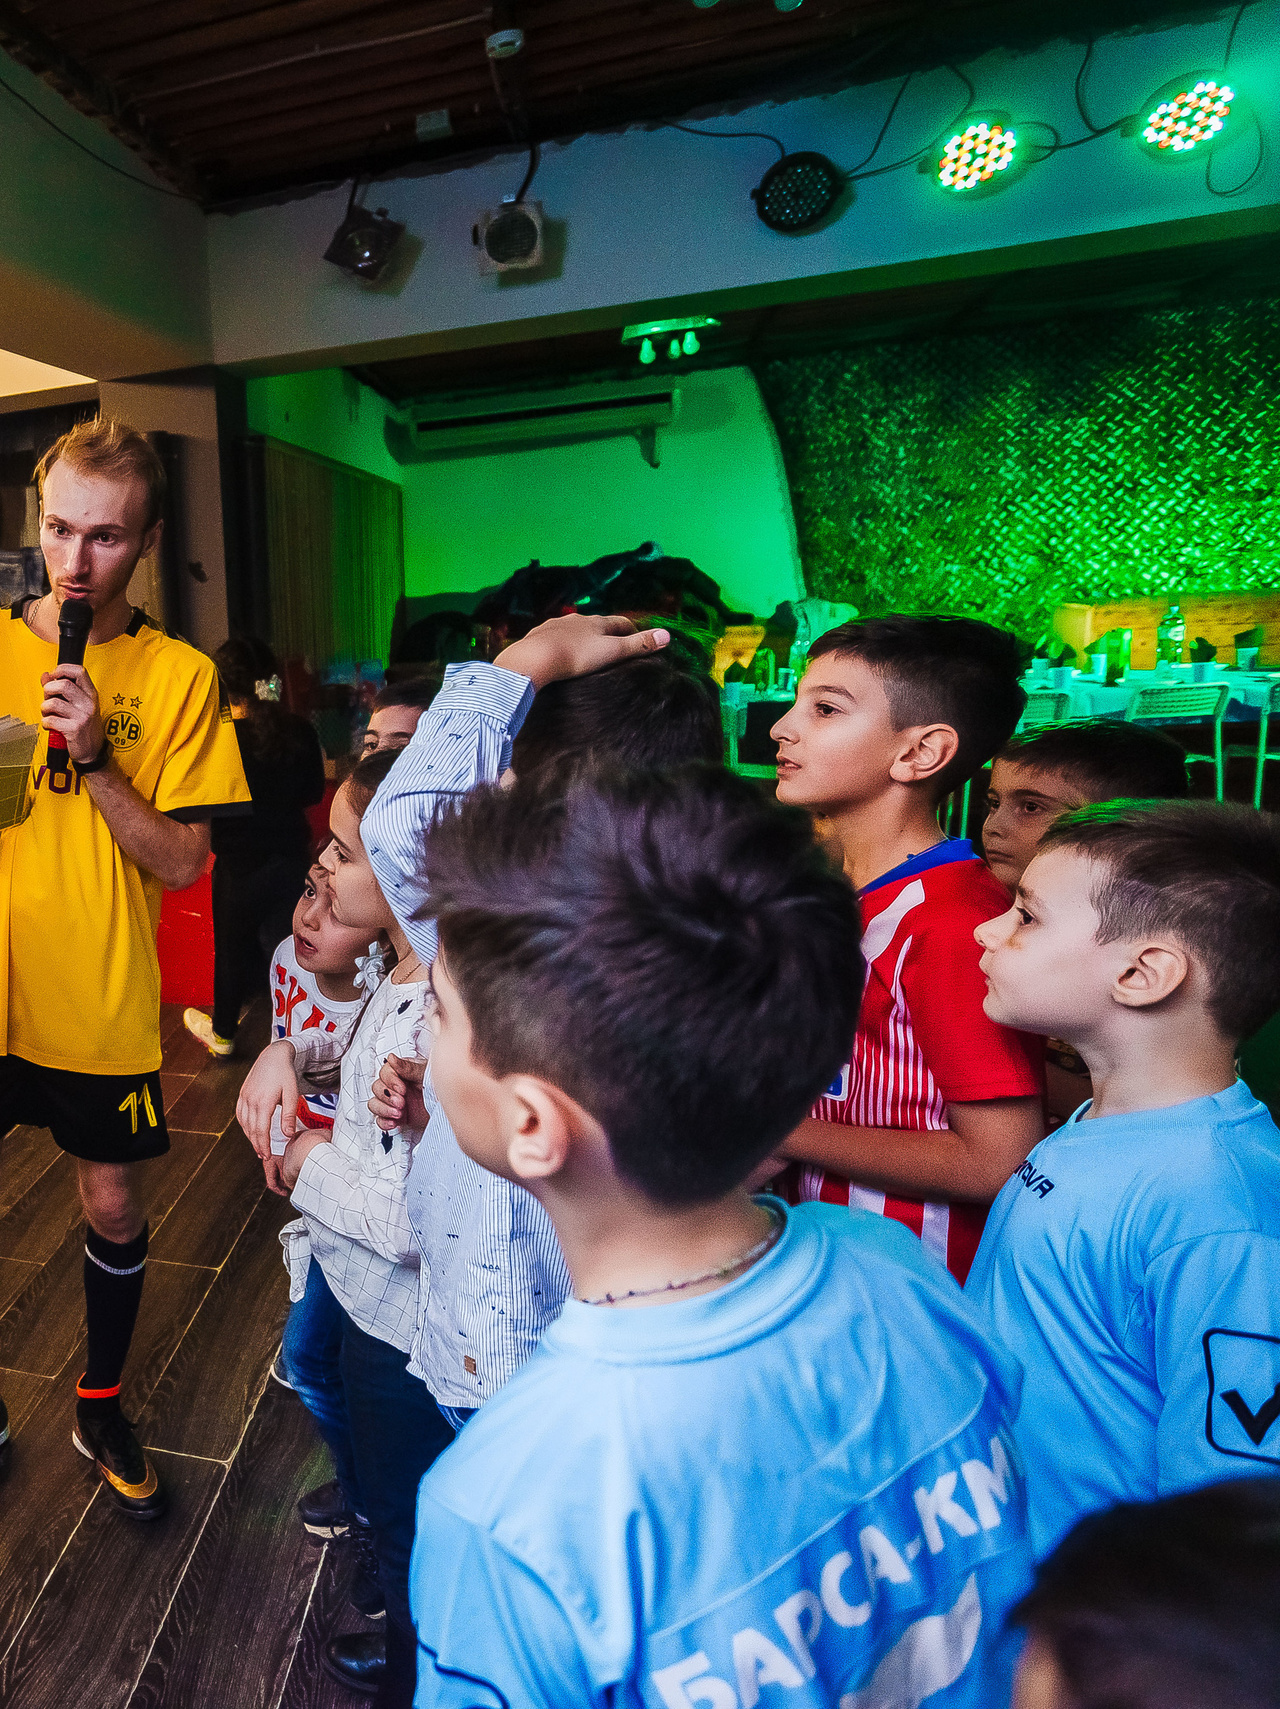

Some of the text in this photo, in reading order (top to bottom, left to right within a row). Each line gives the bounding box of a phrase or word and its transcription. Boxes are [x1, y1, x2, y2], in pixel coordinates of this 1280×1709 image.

[107, 714, 139, 740] BVB
[115, 737, 126, 745] 09
[118, 1082, 158, 1134] 11
